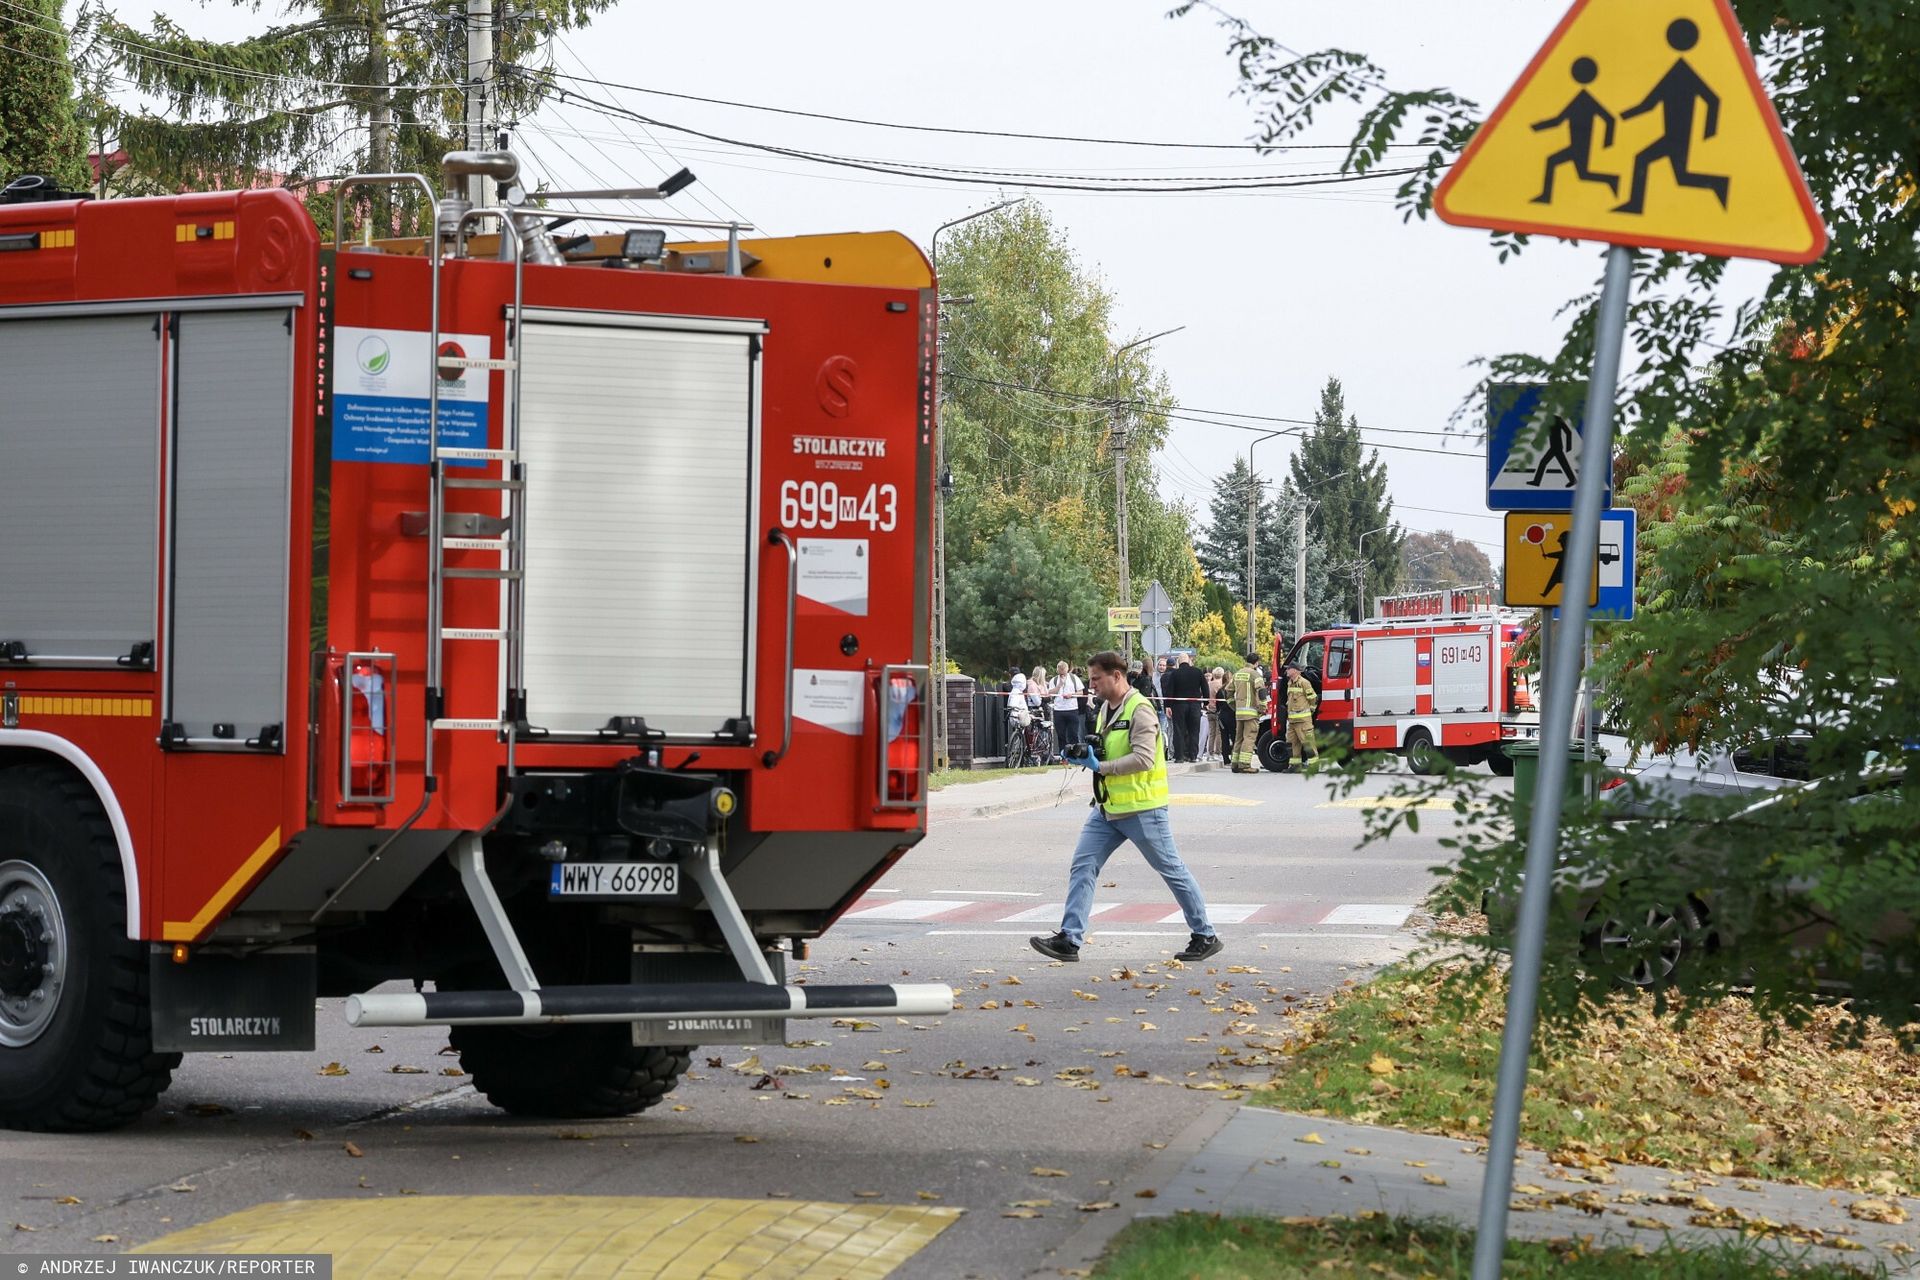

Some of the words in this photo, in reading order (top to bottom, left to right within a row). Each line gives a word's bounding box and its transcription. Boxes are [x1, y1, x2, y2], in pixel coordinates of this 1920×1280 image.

[317, 266, 328, 416] STOLARCZYK
[793, 437, 886, 457] STOLARCZYK
[563, 866, 603, 892] WWY
[611, 866, 675, 892] 66998
[190, 1017, 280, 1036] STOLARCZYK
